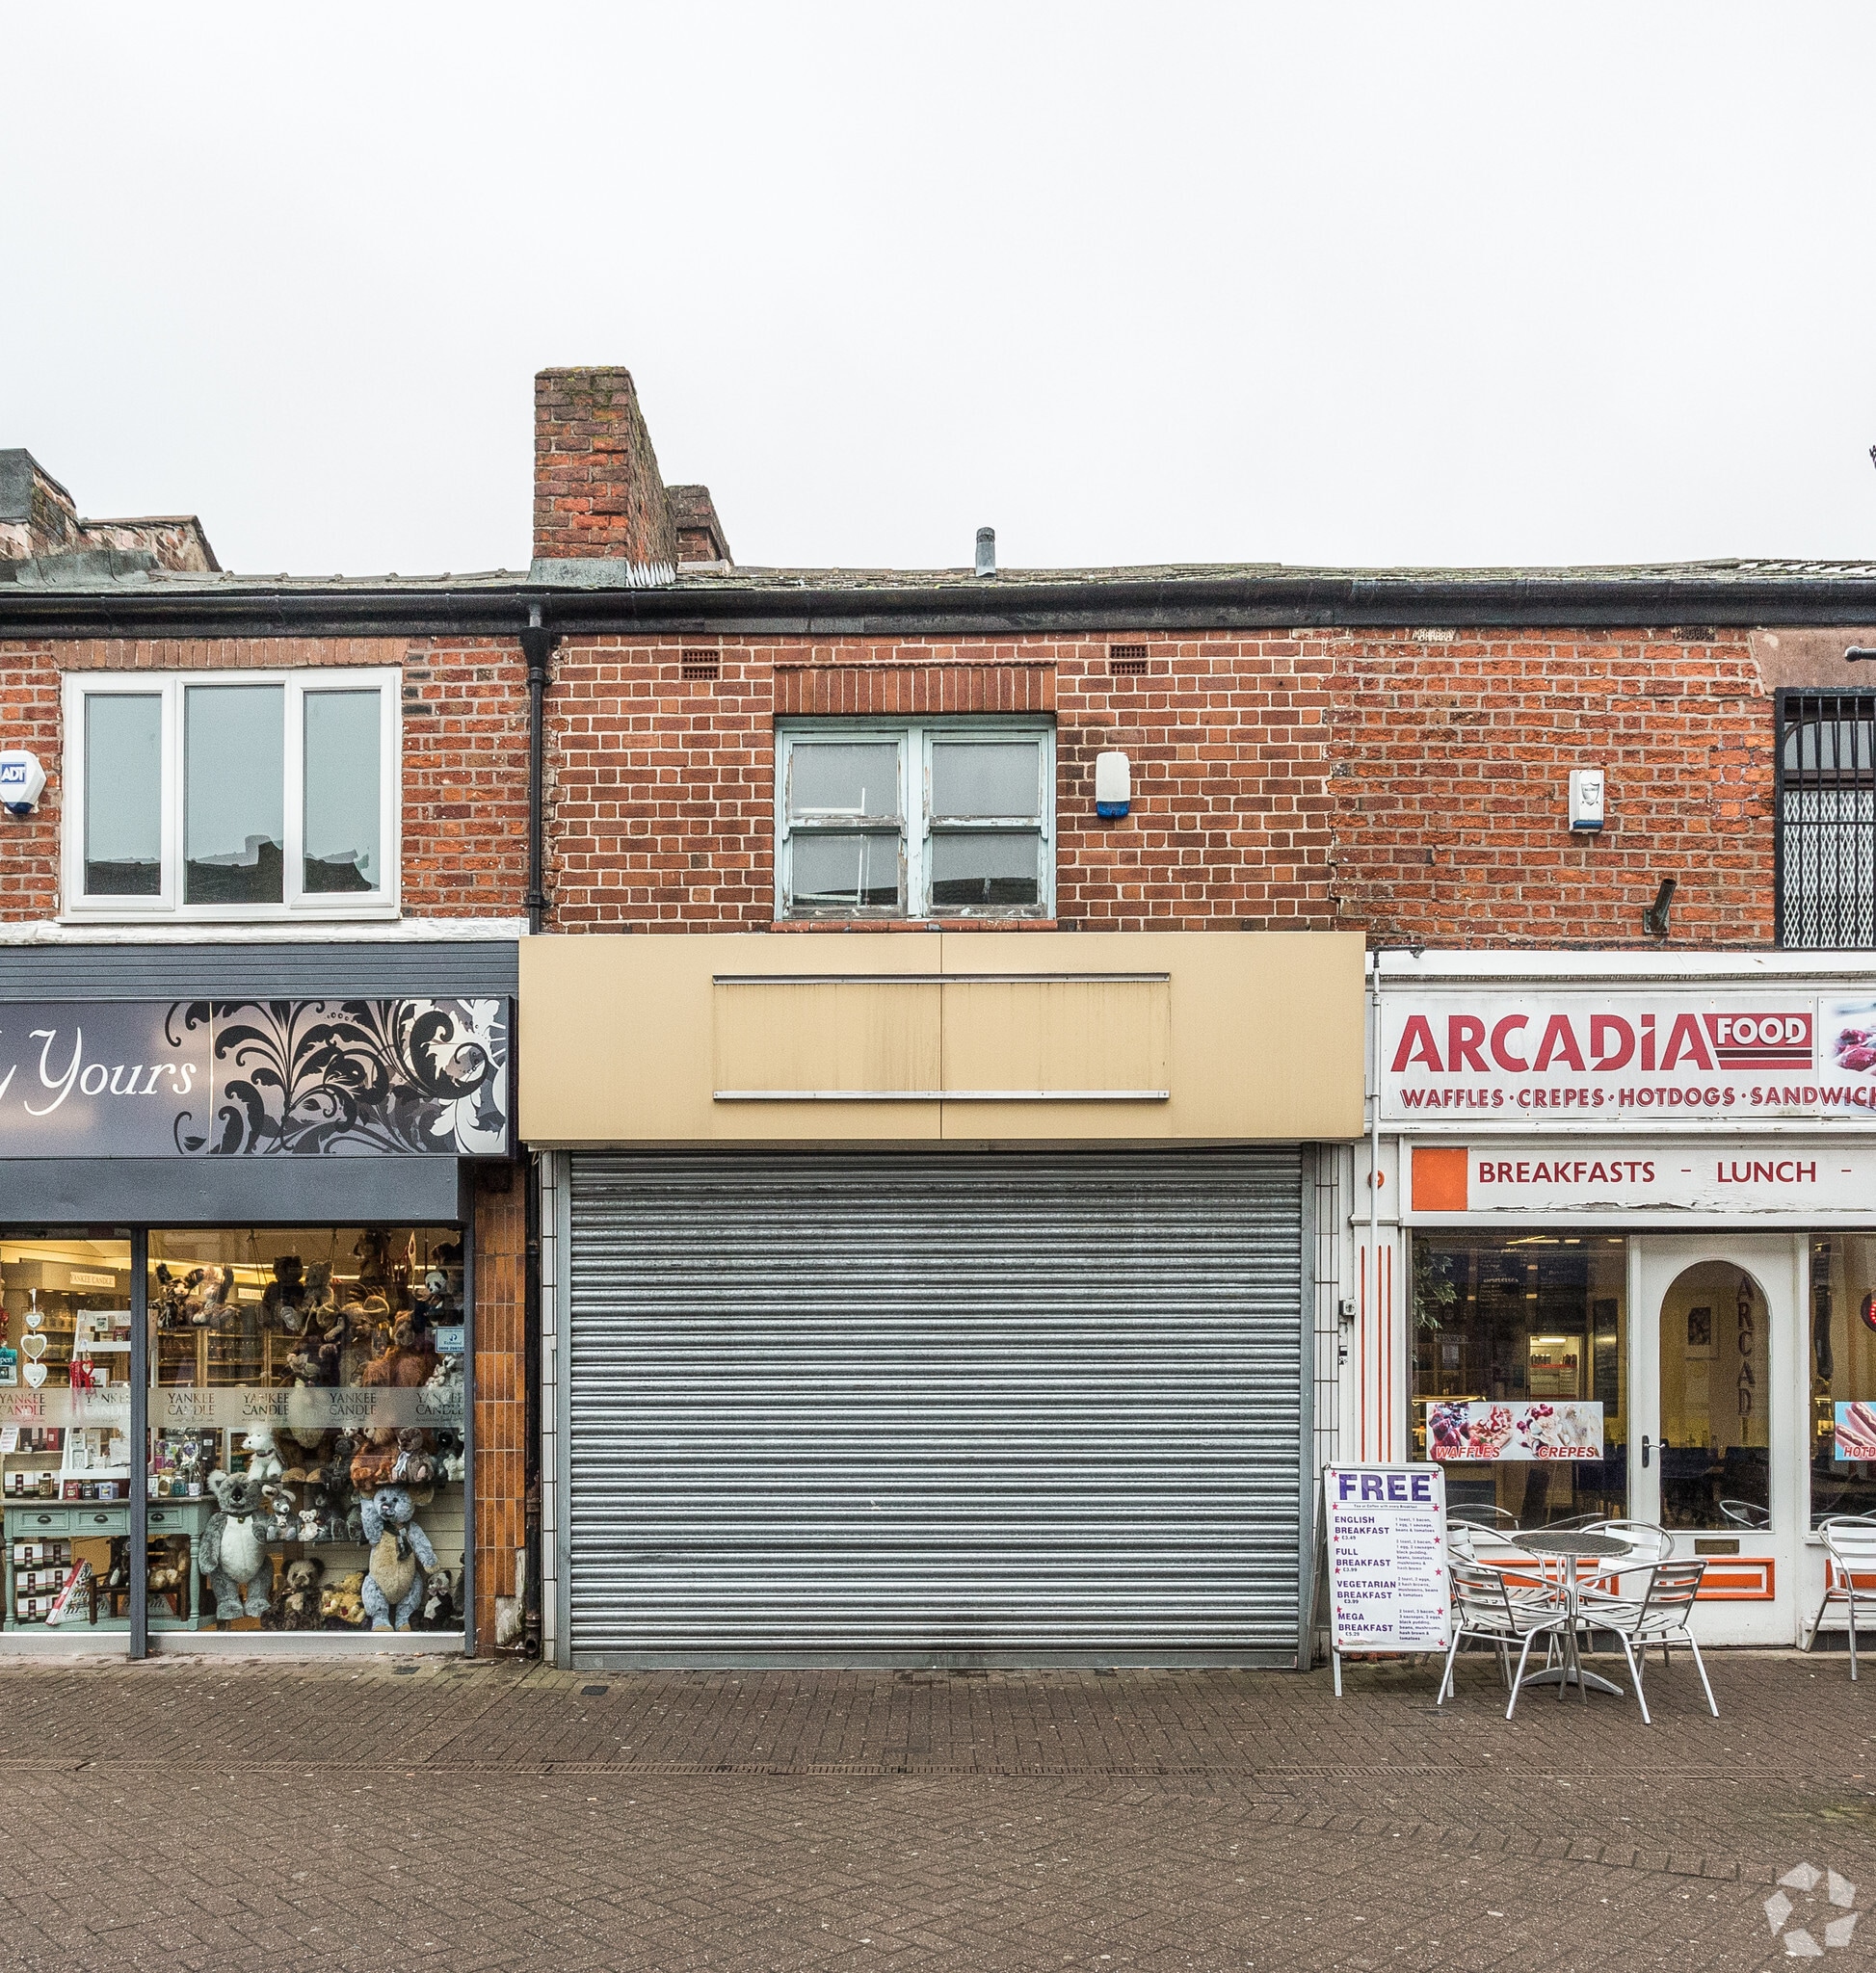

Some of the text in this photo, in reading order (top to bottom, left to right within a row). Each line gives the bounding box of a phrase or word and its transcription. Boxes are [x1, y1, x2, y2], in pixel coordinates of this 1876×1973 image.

[1, 766, 26, 781] ADT
[1717, 1016, 1807, 1044] FOOD
[24, 1027, 198, 1116] Yours
[1400, 1089, 1504, 1108] WAFFLES
[1517, 1089, 1604, 1108] CREPES
[1619, 1087, 1735, 1107] HOTDOGS
[1479, 1162, 1655, 1183] BREAKFASTS
[1717, 1162, 1816, 1183] LUNCH
[243, 1393, 289, 1404] YANKEE
[329, 1393, 377, 1404] YANKEE
[243, 1405, 289, 1415] CANDLE
[329, 1405, 377, 1415] CANDLE
[415, 1405, 464, 1415] CANDLE
[1437, 1446, 1595, 1458] WAFFLES CREPES
[1338, 1474, 1432, 1502] FREE
[1336, 1580, 1396, 1589] VEGETARIAN
